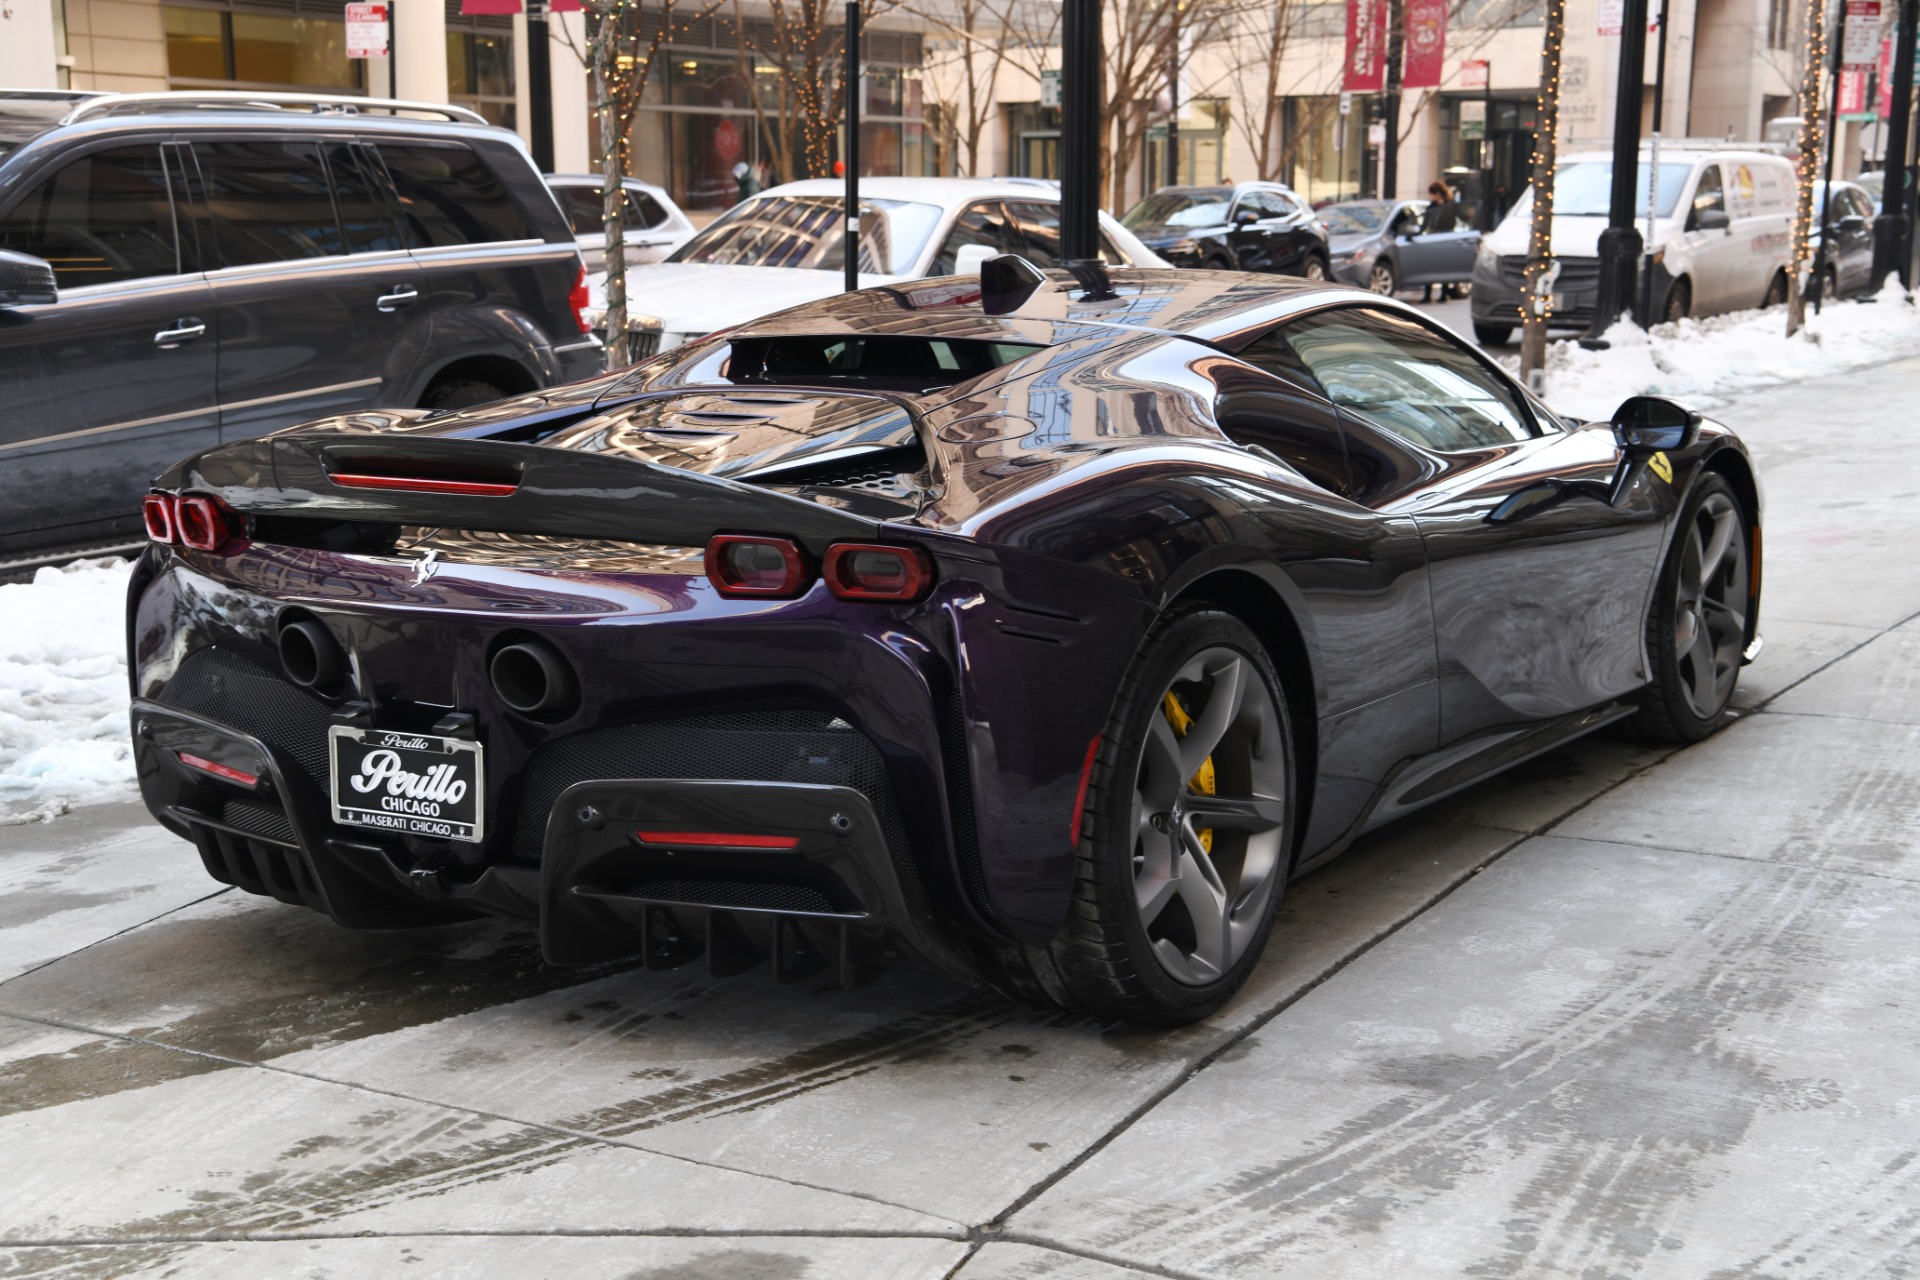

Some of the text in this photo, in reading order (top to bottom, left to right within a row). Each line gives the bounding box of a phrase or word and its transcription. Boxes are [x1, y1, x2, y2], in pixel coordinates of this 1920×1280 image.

[380, 733, 429, 750] Perillo
[350, 749, 467, 805] Perillo
[381, 796, 440, 817] CHICAGO
[362, 813, 450, 836] MASERATI CHICAGO
